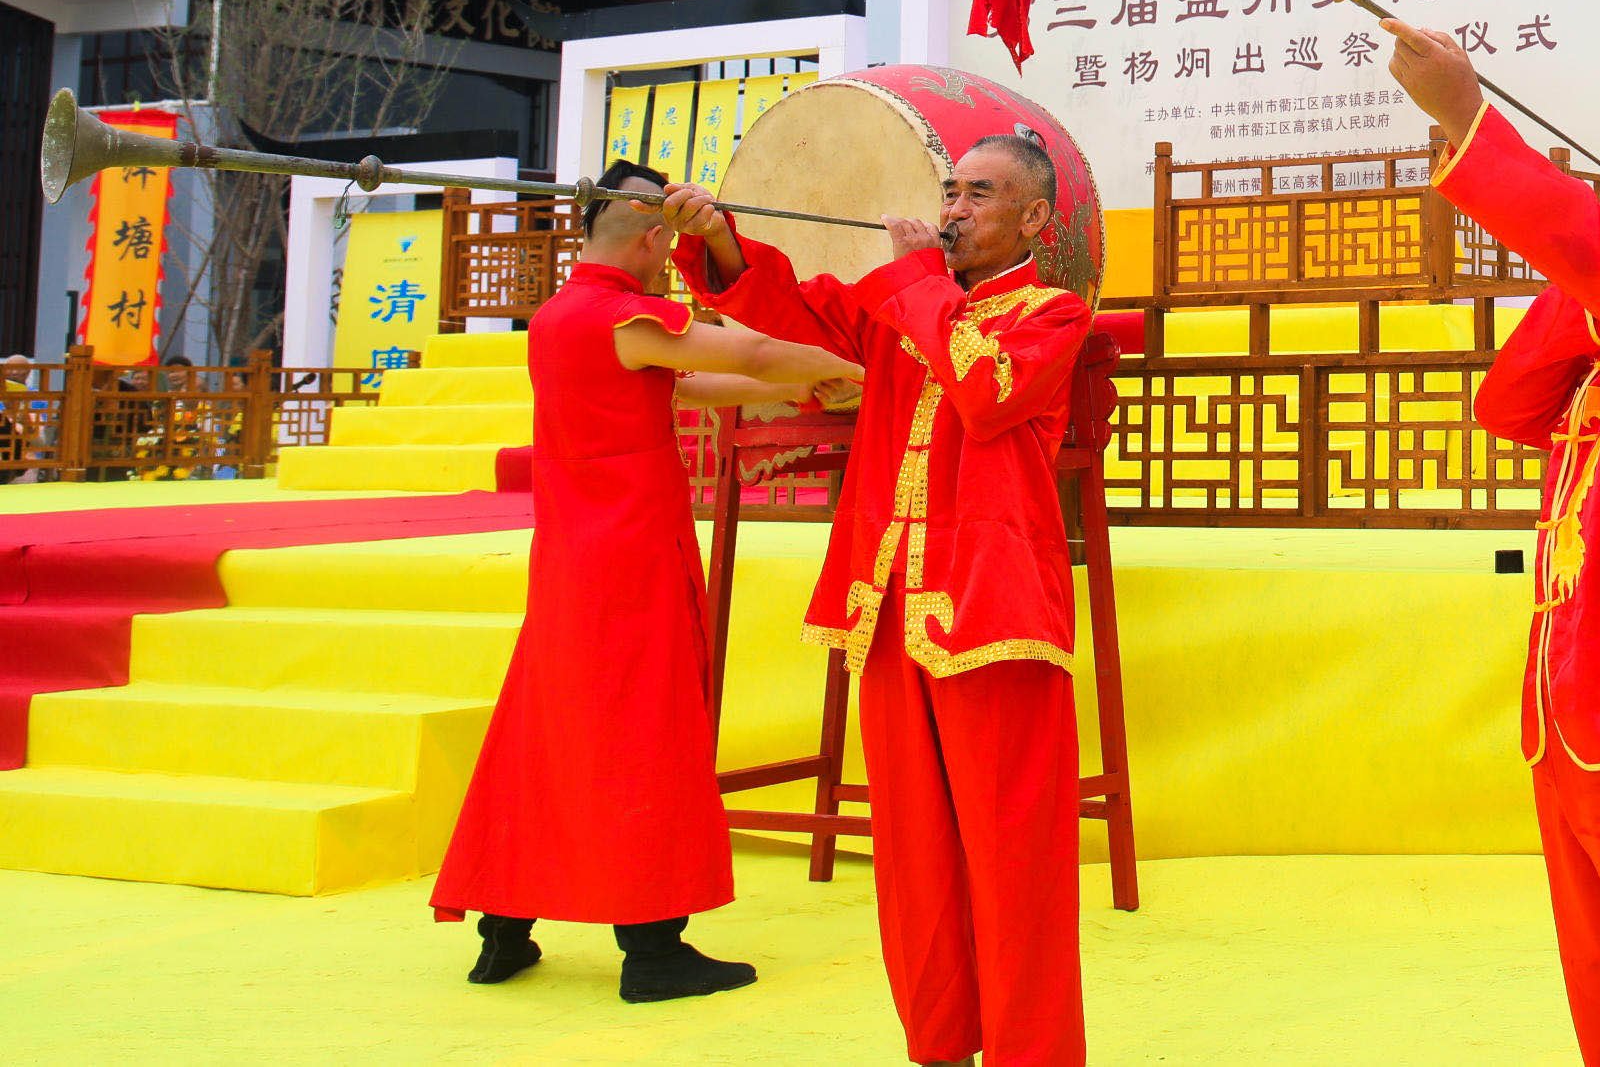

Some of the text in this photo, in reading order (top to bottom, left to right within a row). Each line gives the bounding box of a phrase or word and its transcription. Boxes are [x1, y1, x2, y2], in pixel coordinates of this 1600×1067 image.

[1072, 14, 1558, 89] 暨杨炯出巡祭仪式
